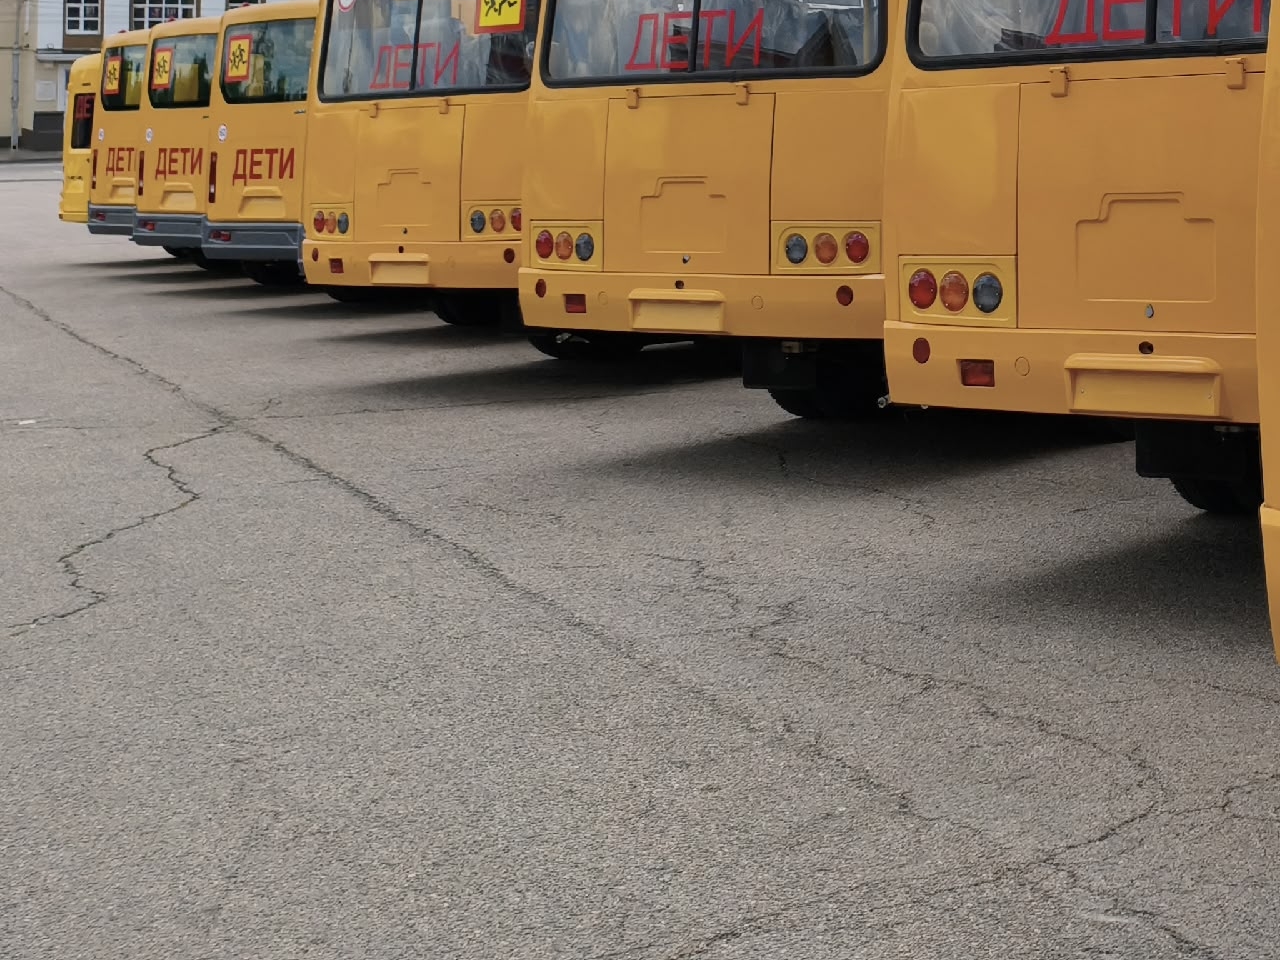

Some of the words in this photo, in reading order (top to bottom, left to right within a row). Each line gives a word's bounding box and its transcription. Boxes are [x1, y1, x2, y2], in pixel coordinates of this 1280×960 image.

[624, 7, 765, 71] ДЕТИ
[369, 37, 461, 91] ДЕТИ
[105, 147, 136, 177] ДЕТ
[155, 147, 204, 181] ДЕТИ
[232, 147, 295, 187] ДЕТИ
